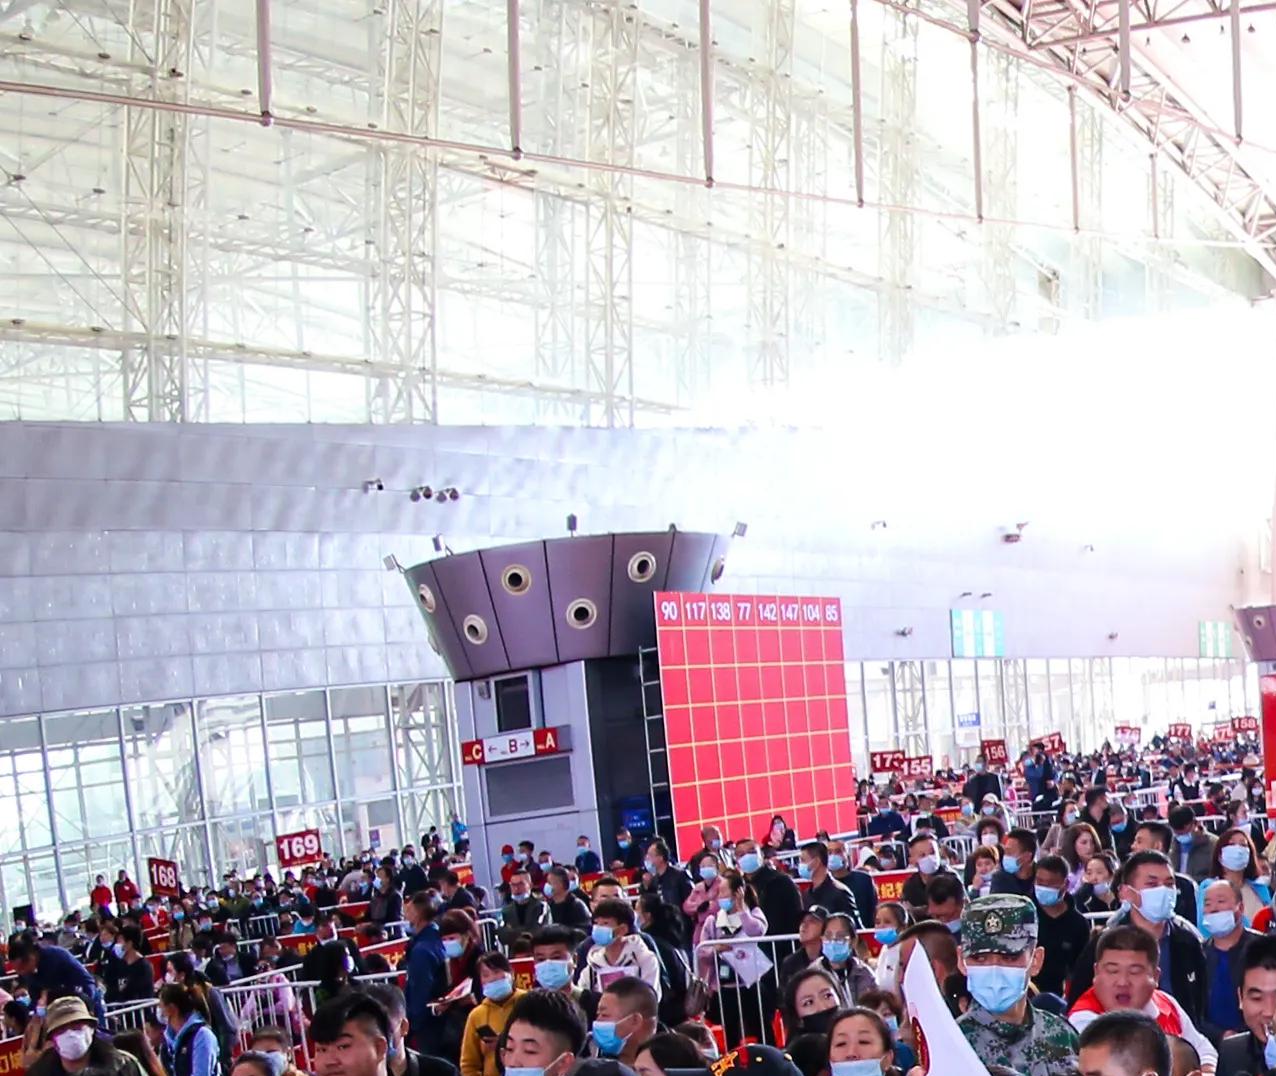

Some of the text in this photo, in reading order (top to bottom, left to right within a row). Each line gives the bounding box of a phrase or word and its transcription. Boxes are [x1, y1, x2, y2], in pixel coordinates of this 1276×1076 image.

[661, 602, 838, 621] 90 117 138 77 142 147 104 85
[472, 732, 556, 760] C B A
[984, 743, 1005, 760] 156
[901, 758, 931, 775] 155
[279, 834, 320, 859] 169
[150, 864, 176, 888] 168
